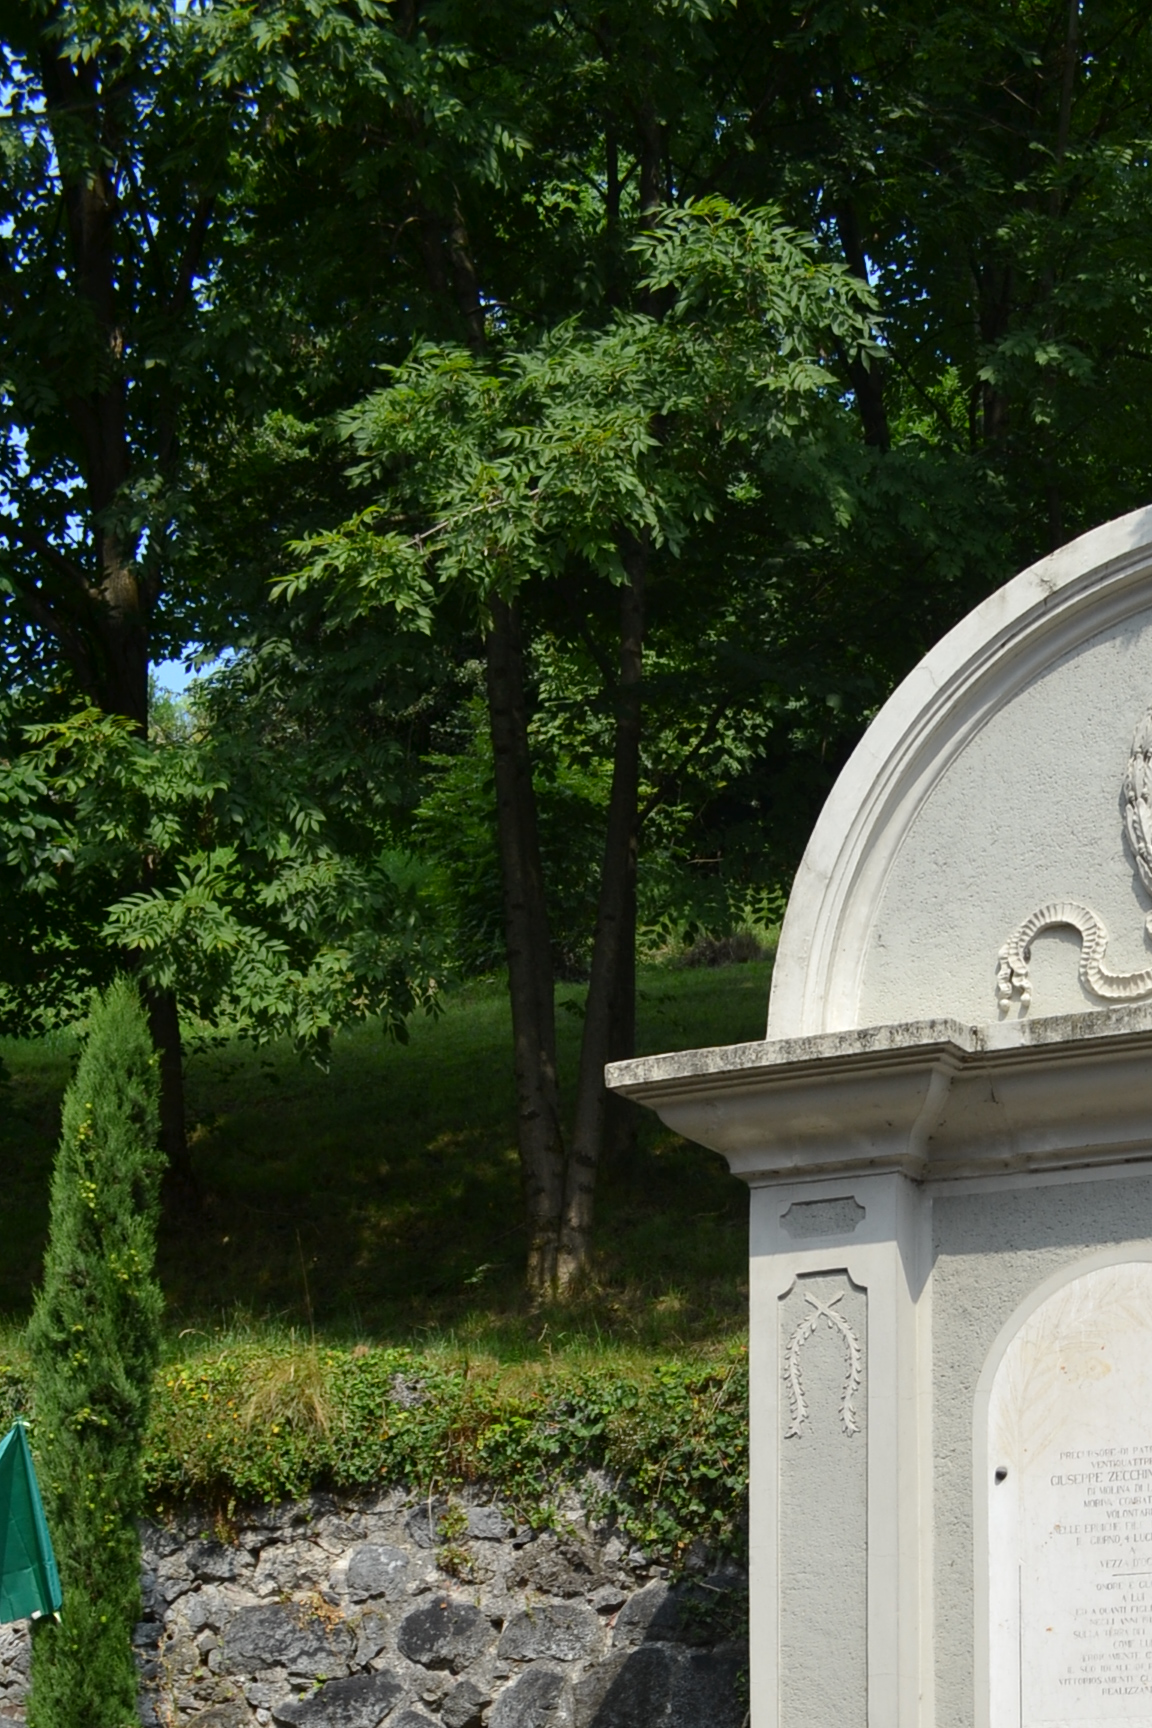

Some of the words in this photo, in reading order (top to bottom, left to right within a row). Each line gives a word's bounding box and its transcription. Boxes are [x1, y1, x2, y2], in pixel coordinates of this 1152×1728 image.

[1051, 1472, 1103, 1486] GIUSEPPE
[1099, 1485, 1130, 1494] MOLINA
[1135, 1484, 1142, 1492] DI
[1125, 1535, 1130, 1543] 4
[1100, 1559, 1129, 1568] VEZZA
[1096, 1582, 1123, 1591] ONORE
[1131, 1593, 1145, 1602] LUI
[1099, 1605, 1127, 1615] QUANTI
